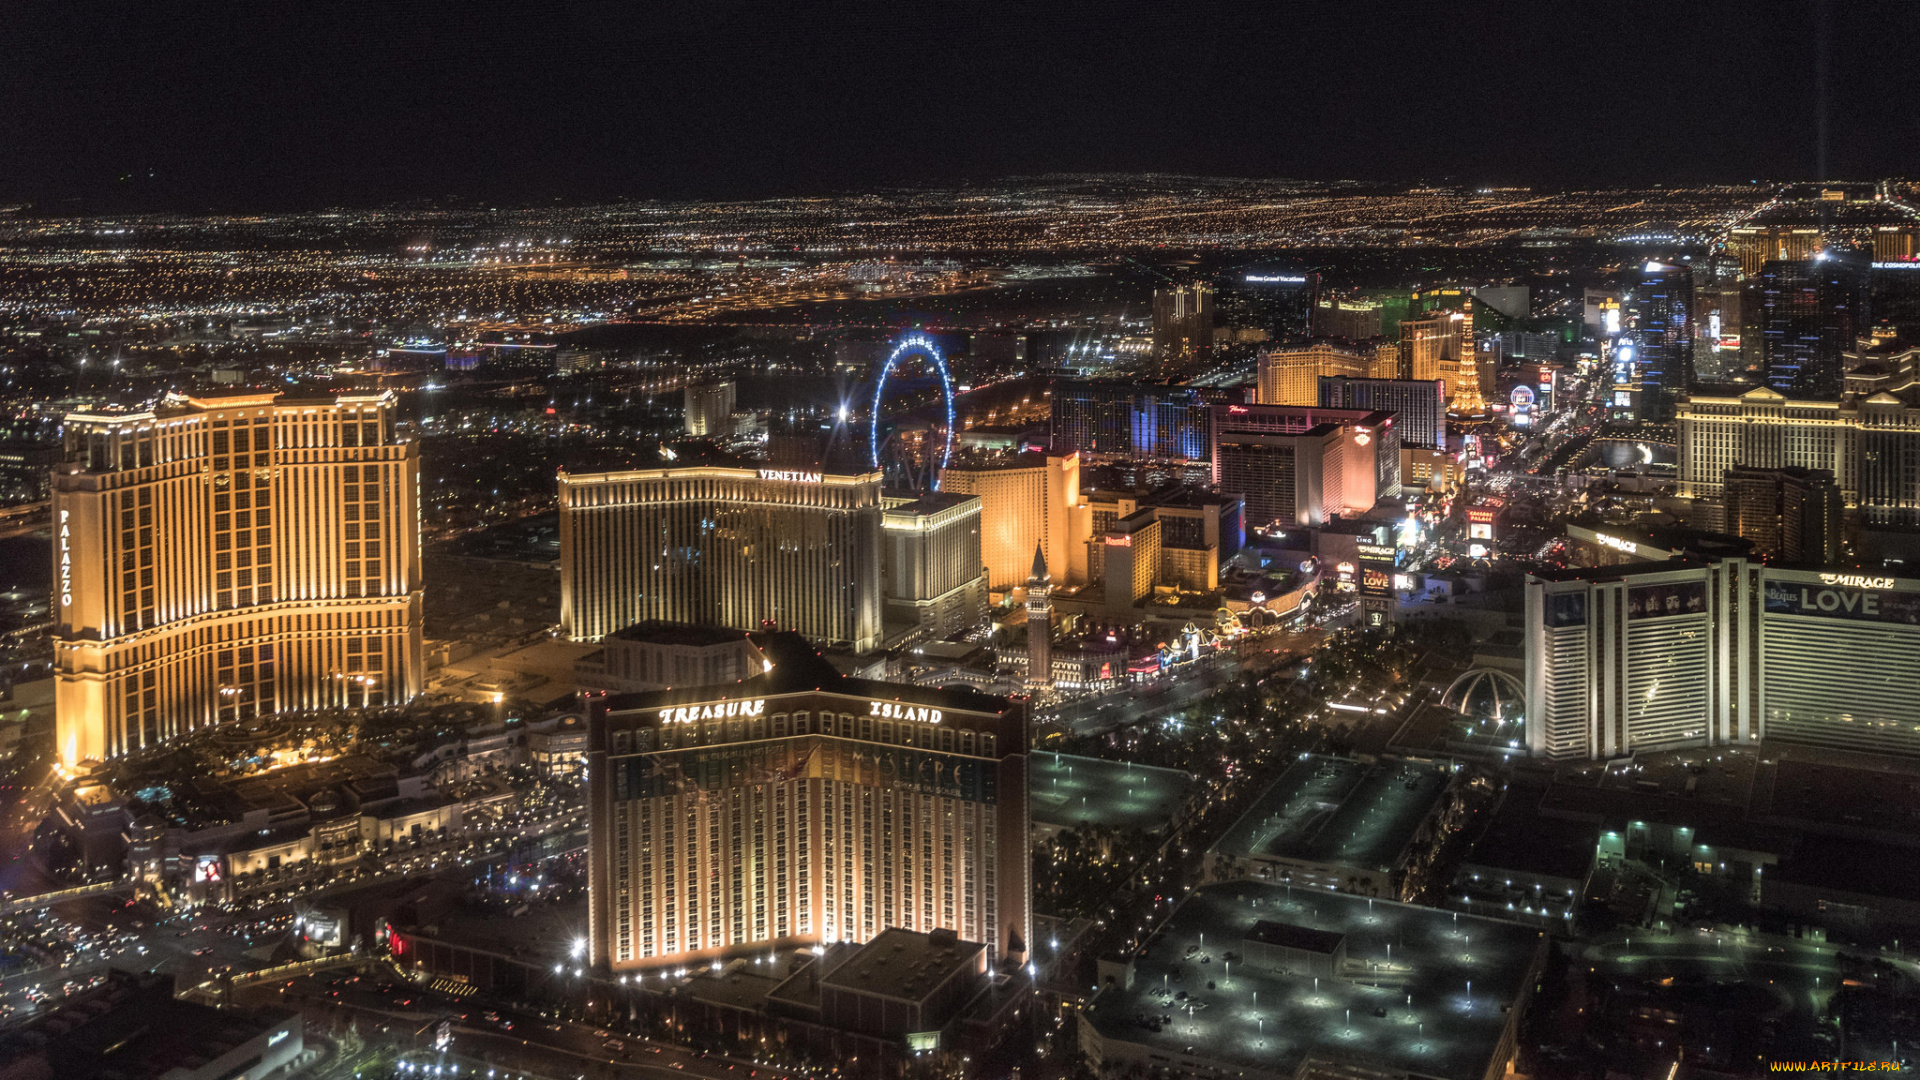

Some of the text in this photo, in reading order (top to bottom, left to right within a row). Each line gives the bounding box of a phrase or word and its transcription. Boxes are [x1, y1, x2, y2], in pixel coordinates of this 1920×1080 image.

[759, 469, 823, 482] VENETIAN
[60, 510, 72, 606] PALAZZO
[1363, 577, 1389, 587] LOVE
[1819, 573, 1894, 589] THE MIRAGE
[1801, 588, 1880, 615] LOVE
[659, 700, 942, 724] TREASURE ISLAND
